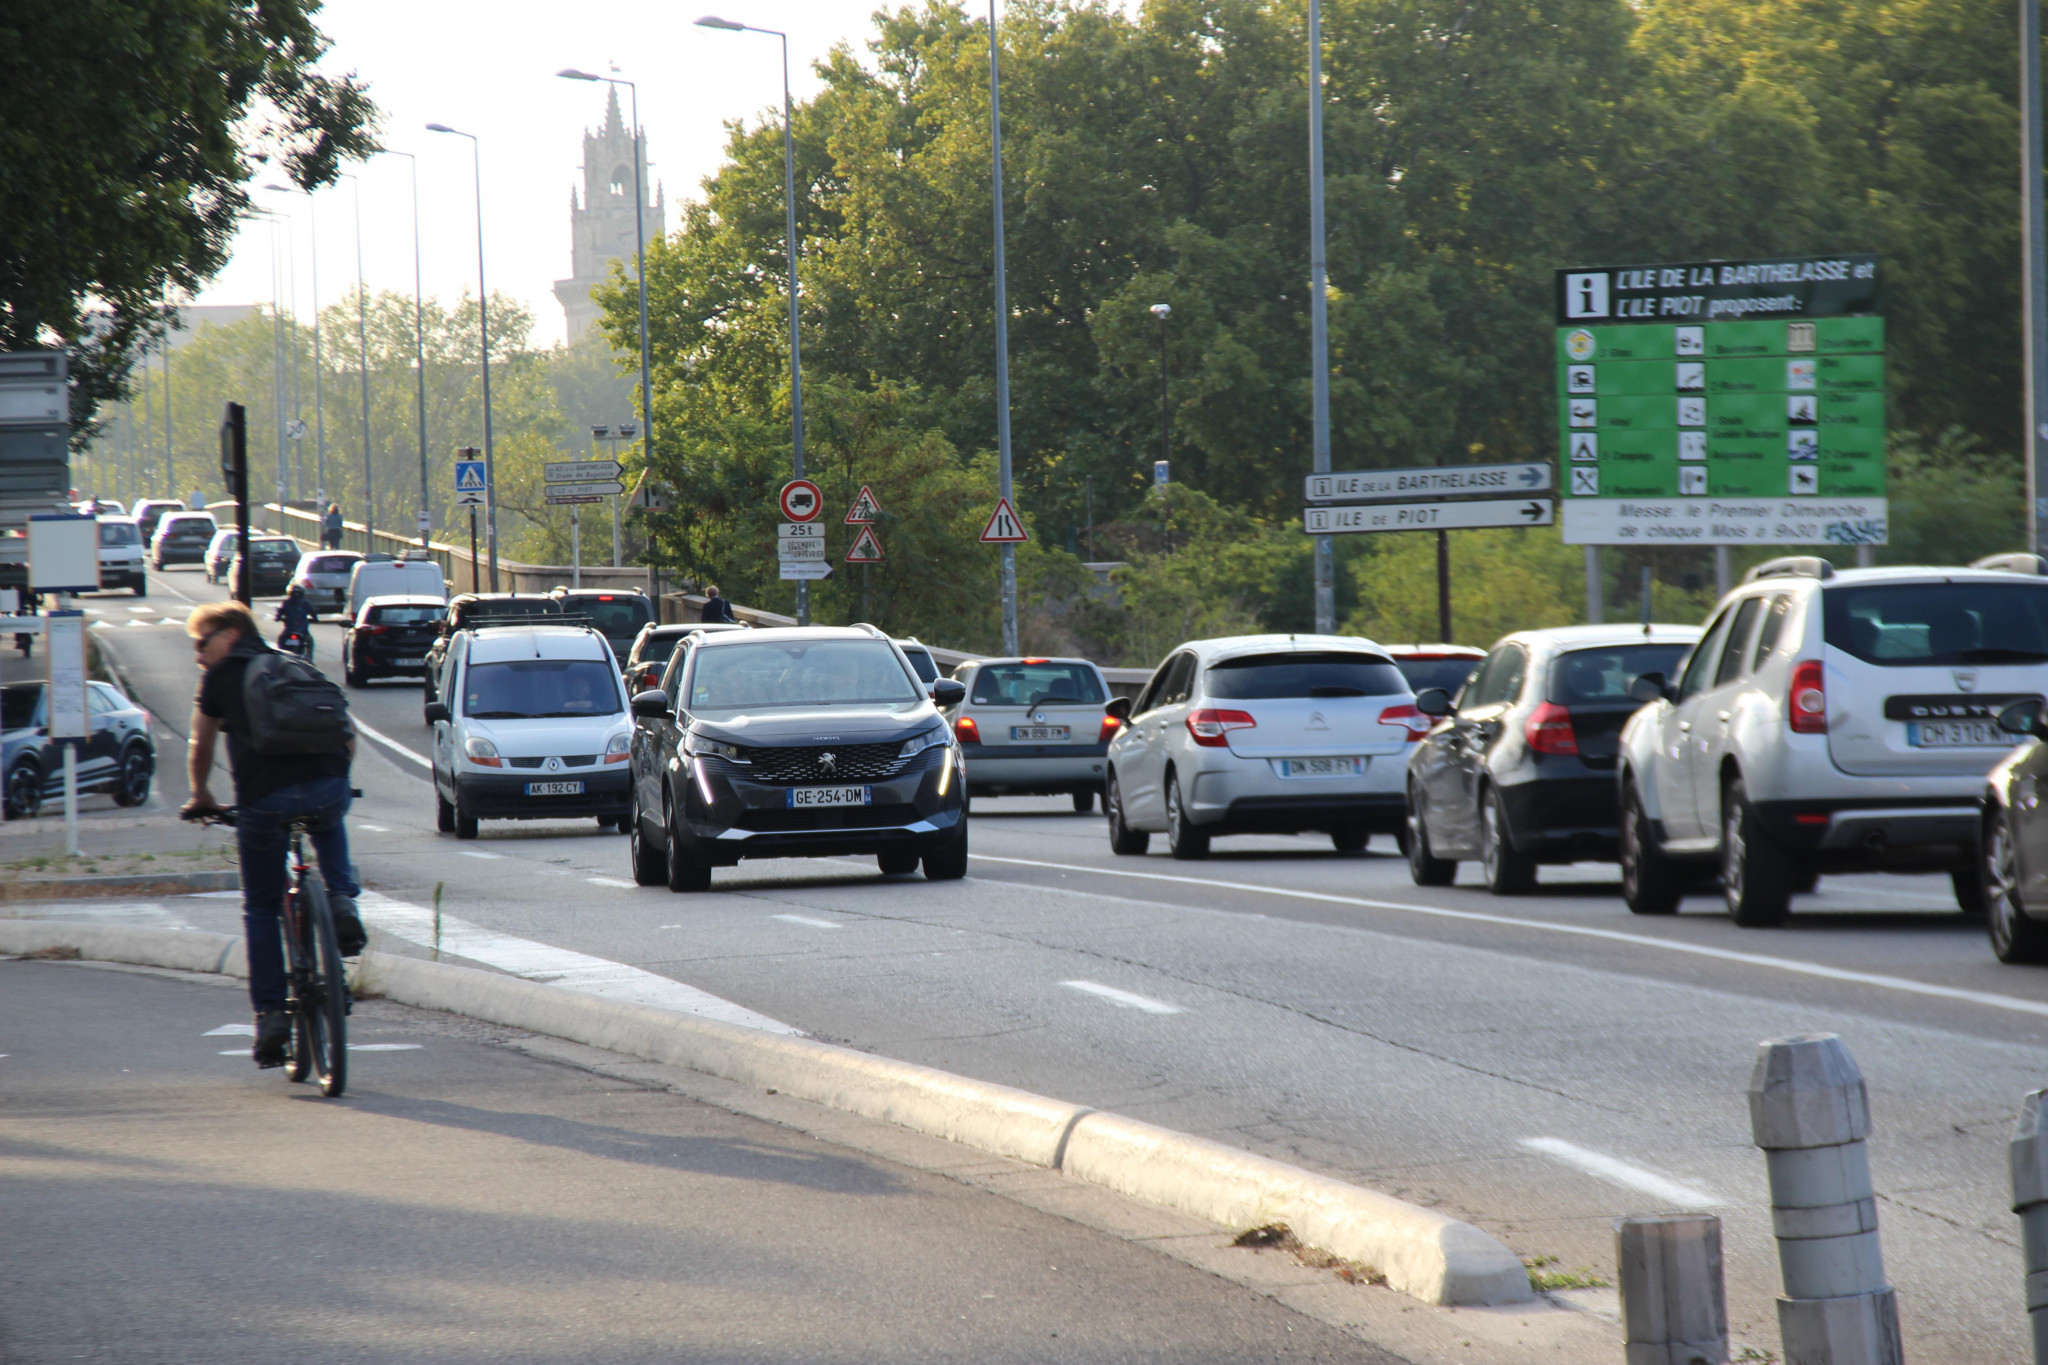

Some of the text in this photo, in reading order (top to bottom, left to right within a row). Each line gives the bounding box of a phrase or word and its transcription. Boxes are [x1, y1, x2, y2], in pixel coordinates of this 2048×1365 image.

[1660, 268, 1687, 287] DE
[1690, 267, 1715, 286] LA
[1720, 260, 1850, 285] BARTHELASSE
[1853, 262, 1876, 279] et
[1660, 296, 1705, 316] PIOT
[1337, 471, 1509, 493] ILE DE LA BARTHELASSE
[1336, 509, 1440, 526] ILE DE PIOT
[1686, 503, 1702, 518] le
[1709, 503, 1773, 518] Premier
[1781, 503, 1867, 518] Dimanche
[790, 525, 813, 536] 25 t
[1618, 524, 1639, 538] de
[1646, 524, 1704, 540] chaque
[1711, 524, 1749, 538] Mois
